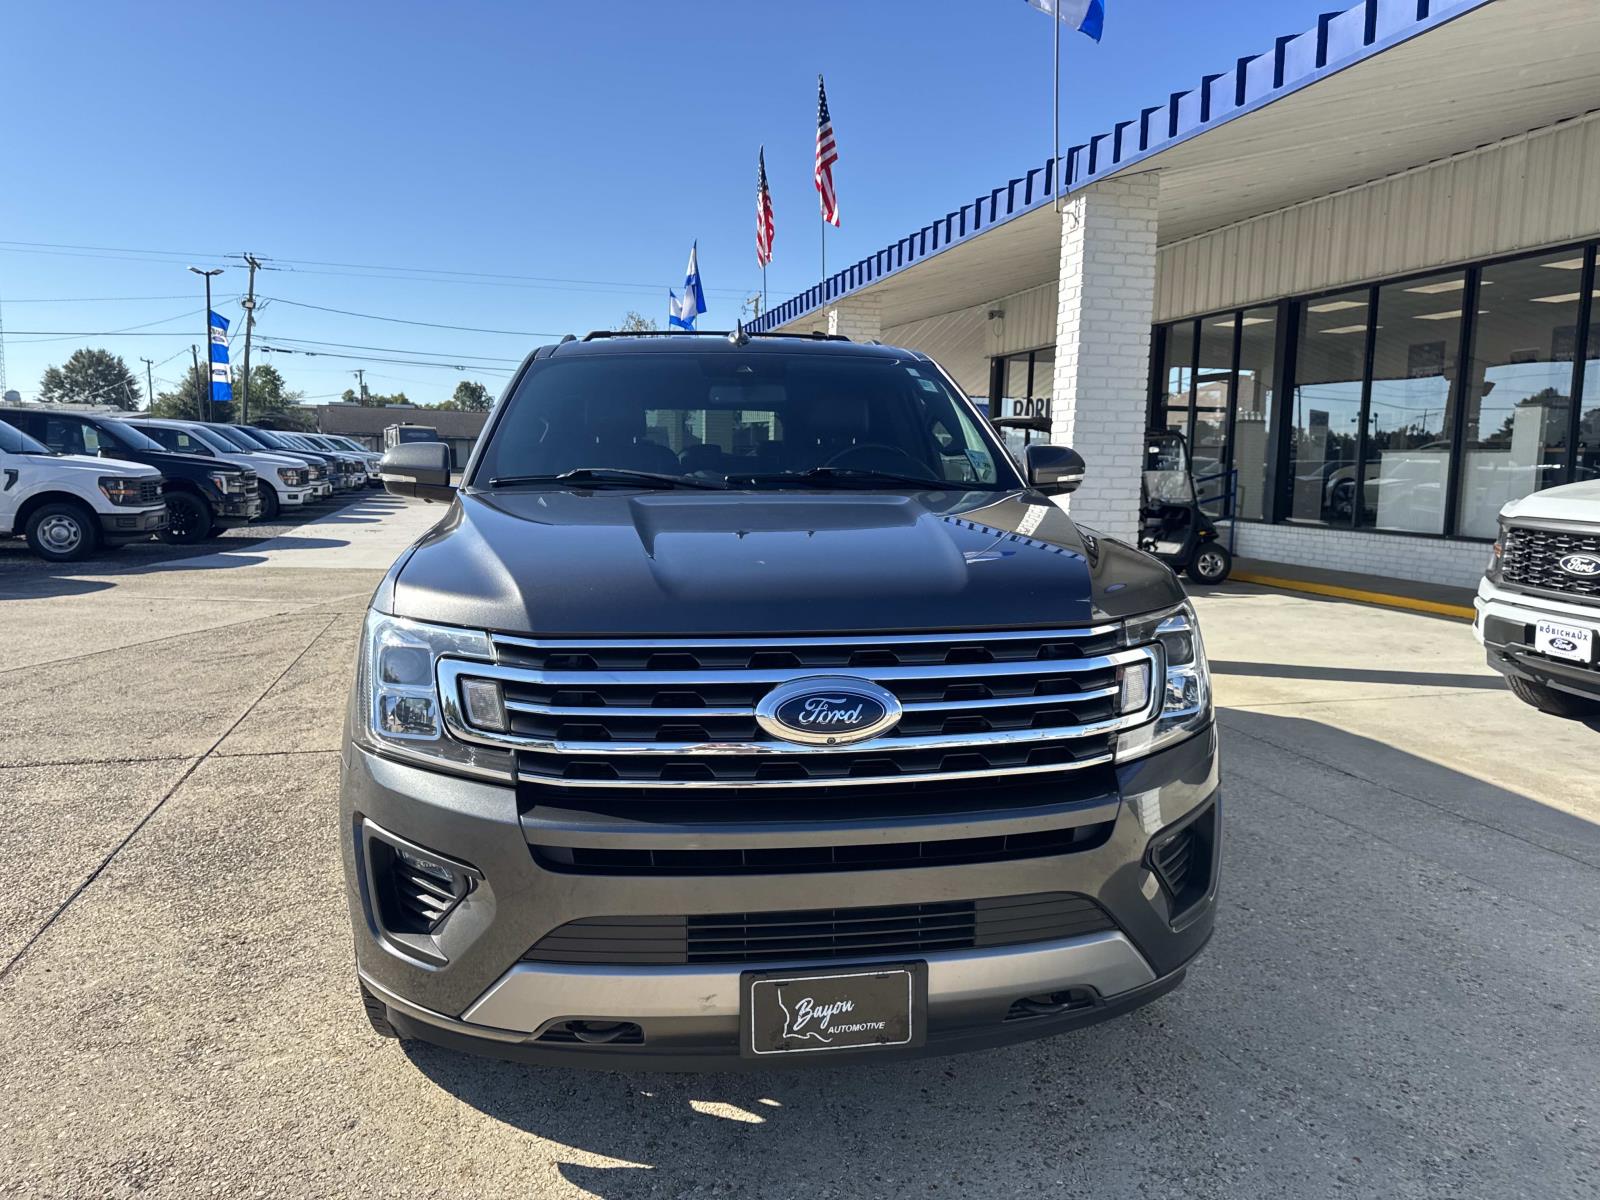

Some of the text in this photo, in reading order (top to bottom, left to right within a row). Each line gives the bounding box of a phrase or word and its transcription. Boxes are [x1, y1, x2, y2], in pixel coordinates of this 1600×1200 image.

[1566, 557, 1596, 572] Ford
[798, 697, 863, 725] Ford
[793, 997, 854, 1031] Bayou
[827, 1021, 886, 1034] AUTOMOTIVE
